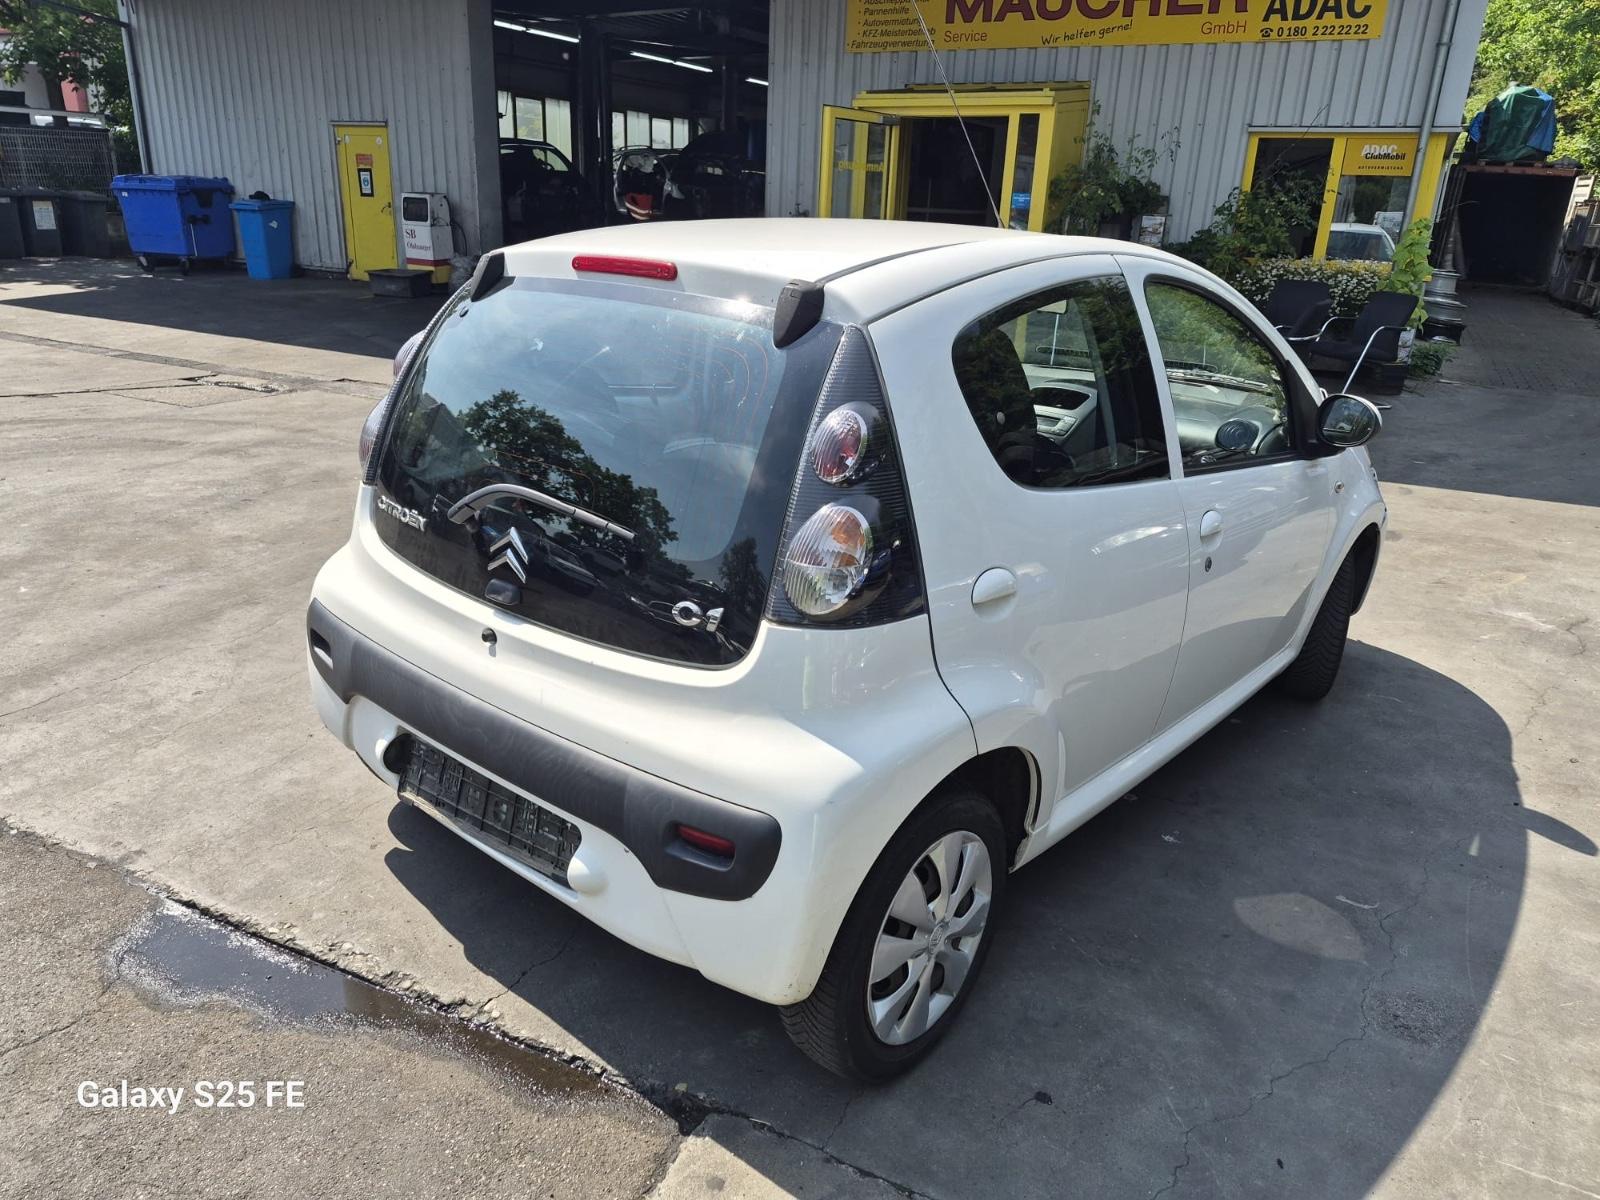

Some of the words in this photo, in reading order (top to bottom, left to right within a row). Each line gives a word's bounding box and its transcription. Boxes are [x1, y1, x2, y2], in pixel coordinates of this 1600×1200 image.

[864, 6, 909, 16] Pannenhilfe
[1262, 0, 1372, 22] ADAC
[1041, 33, 1060, 45] Wir
[1063, 28, 1096, 41] helfen
[1099, 19, 1133, 39] gerne!
[1201, 20, 1247, 35] GmbH
[943, 30, 988, 43] Service
[1361, 144, 1397, 156] ADAC
[1365, 152, 1406, 160] ClubMobil
[405, 229, 416, 239] SB
[671, 600, 725, 632] C1
